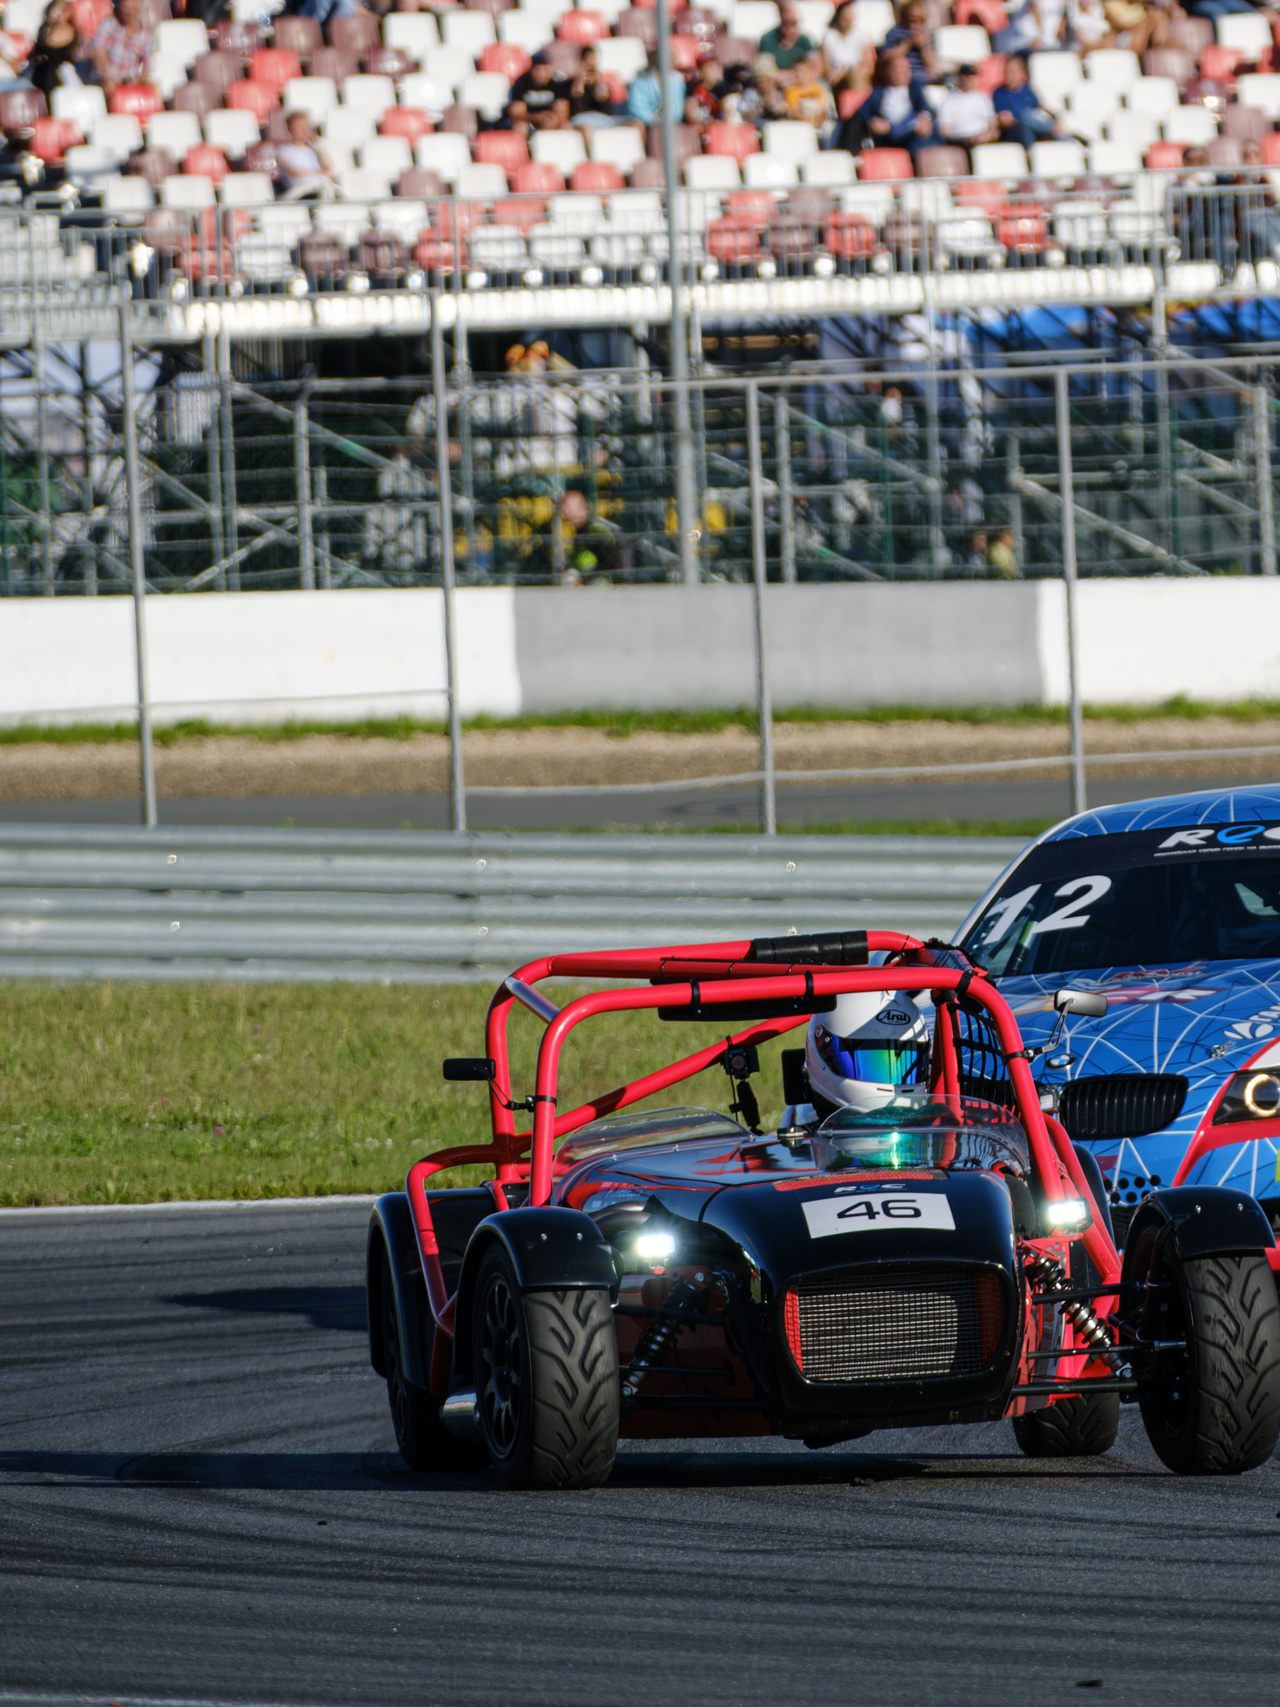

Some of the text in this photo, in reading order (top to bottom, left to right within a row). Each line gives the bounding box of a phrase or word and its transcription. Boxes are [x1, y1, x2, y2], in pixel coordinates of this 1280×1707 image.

[982, 875, 1113, 945] 12
[880, 1010, 908, 1021] Arai
[837, 1199, 922, 1220] 46
